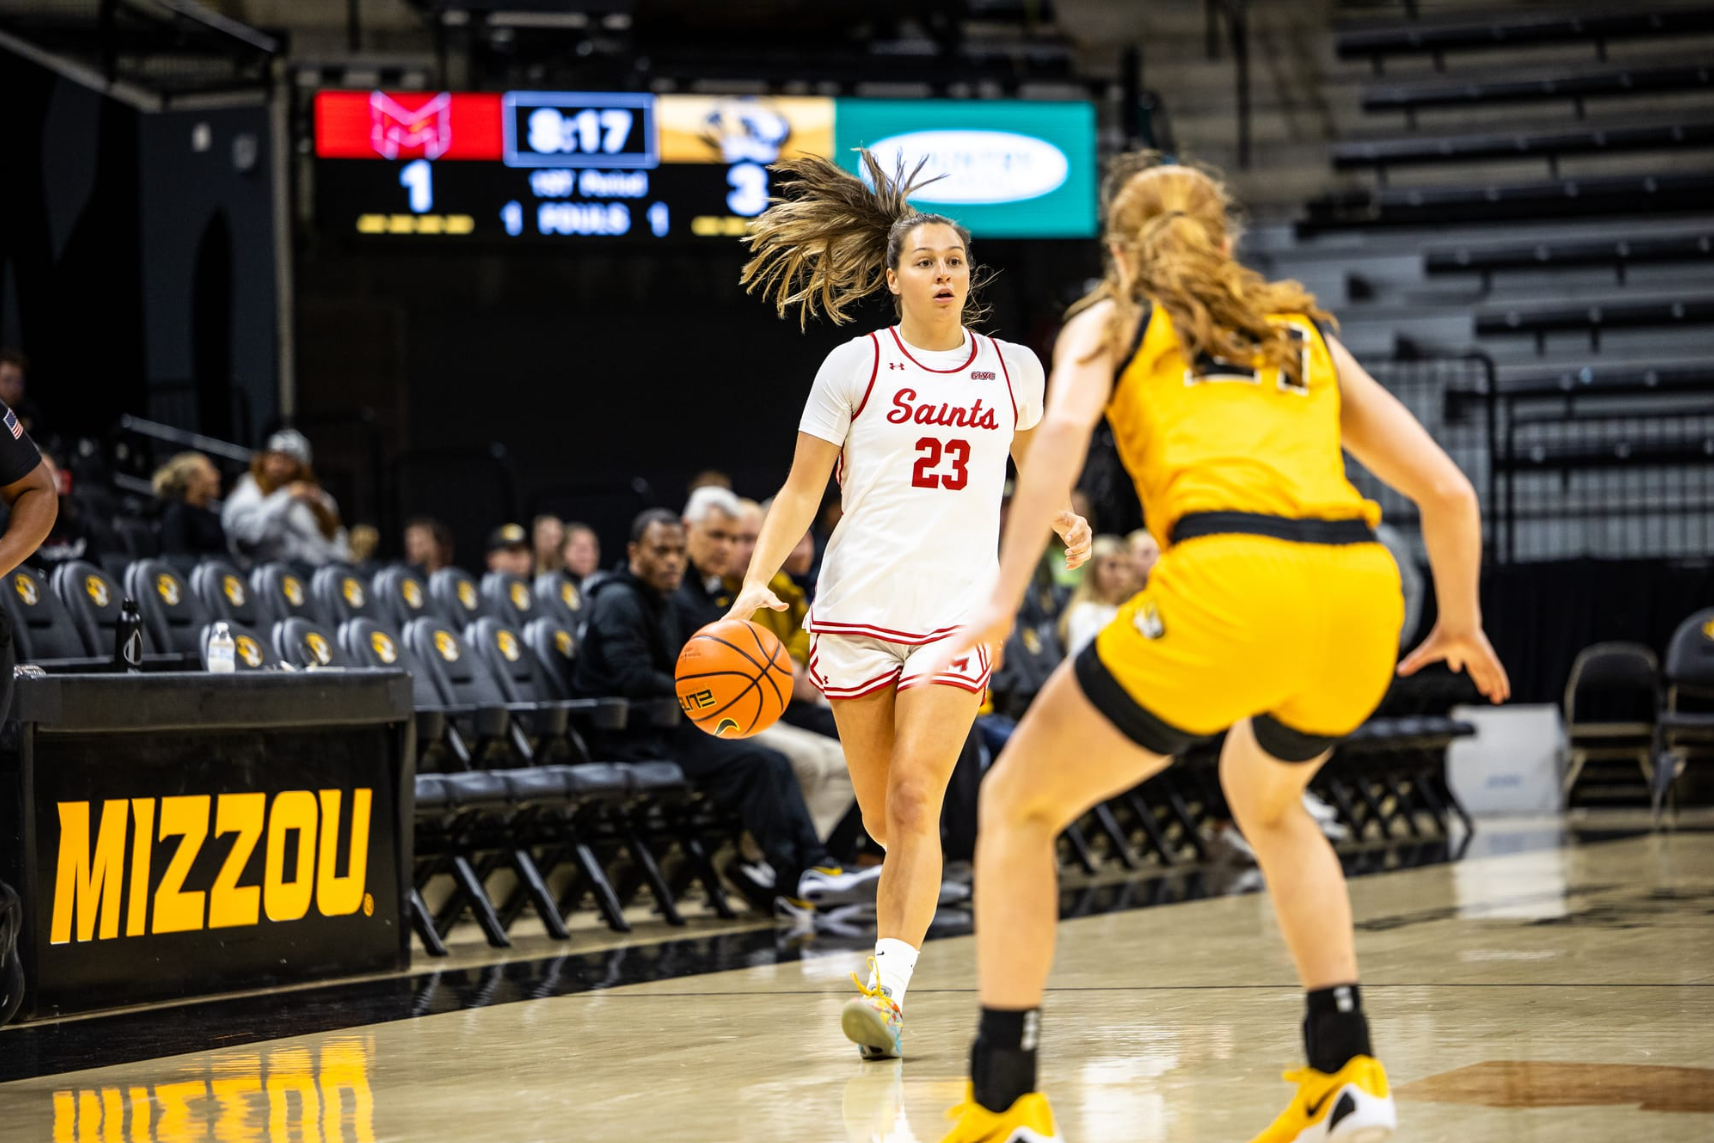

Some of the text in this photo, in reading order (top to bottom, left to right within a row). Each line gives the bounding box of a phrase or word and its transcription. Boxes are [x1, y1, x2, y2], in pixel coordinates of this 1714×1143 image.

[528, 107, 633, 154] 8:17
[400, 159, 433, 213] 1
[726, 163, 769, 216] 3
[500, 200, 523, 236] 1
[646, 201, 670, 237] 1
[886, 388, 999, 430] Saints
[911, 437, 971, 491] 23
[50, 788, 373, 945] MIZZOU
